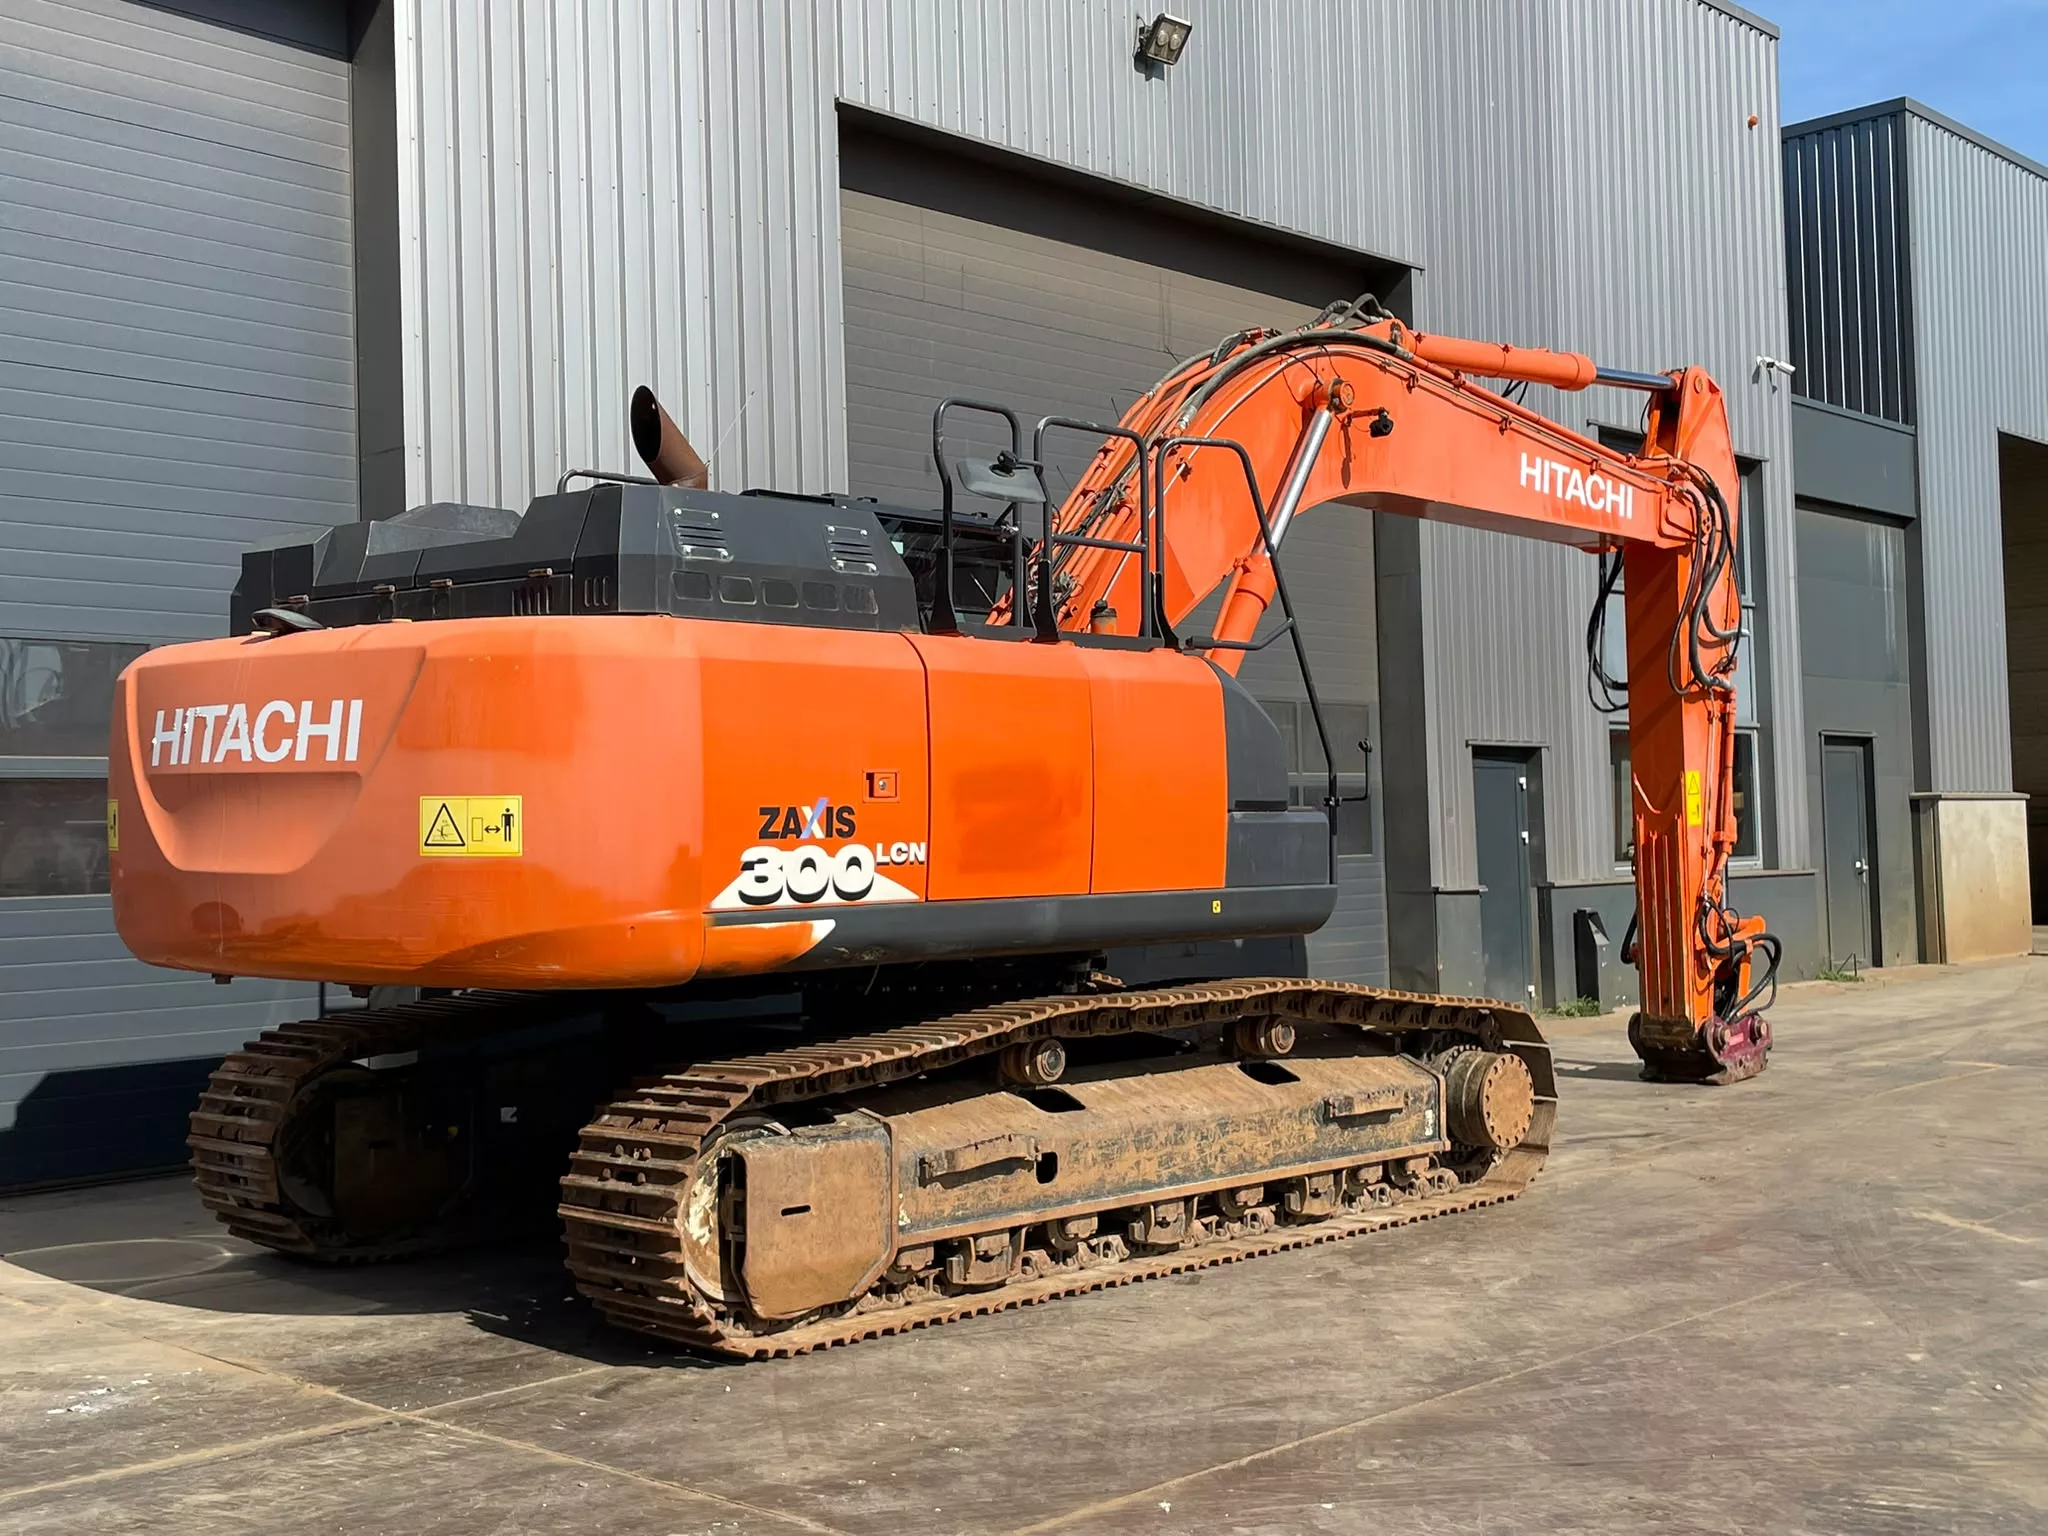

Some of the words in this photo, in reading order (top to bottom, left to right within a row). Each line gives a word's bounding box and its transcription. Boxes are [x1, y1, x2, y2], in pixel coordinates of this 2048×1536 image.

[1520, 452, 1633, 519] HITACHI
[151, 698, 363, 767] HITACHI
[758, 797, 856, 840] ZAXIS
[738, 843, 875, 905] 300
[876, 842, 926, 866] LCN
